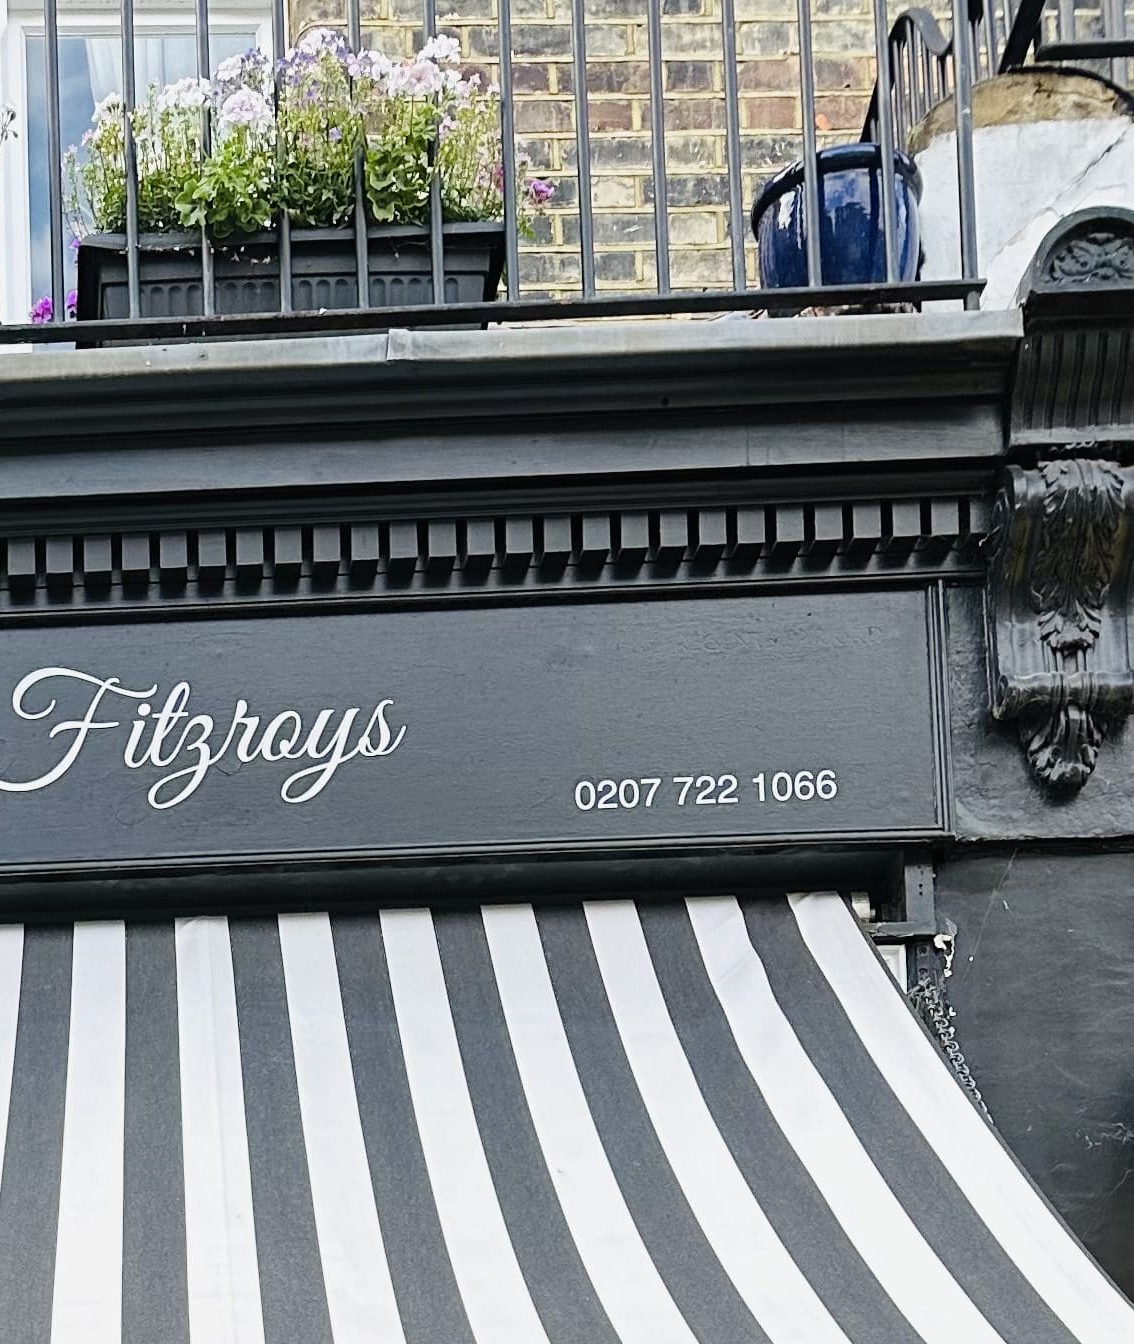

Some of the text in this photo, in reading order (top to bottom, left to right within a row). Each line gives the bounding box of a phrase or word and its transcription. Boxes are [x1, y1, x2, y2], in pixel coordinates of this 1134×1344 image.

[575, 769, 837, 810] 0207 722 1066
